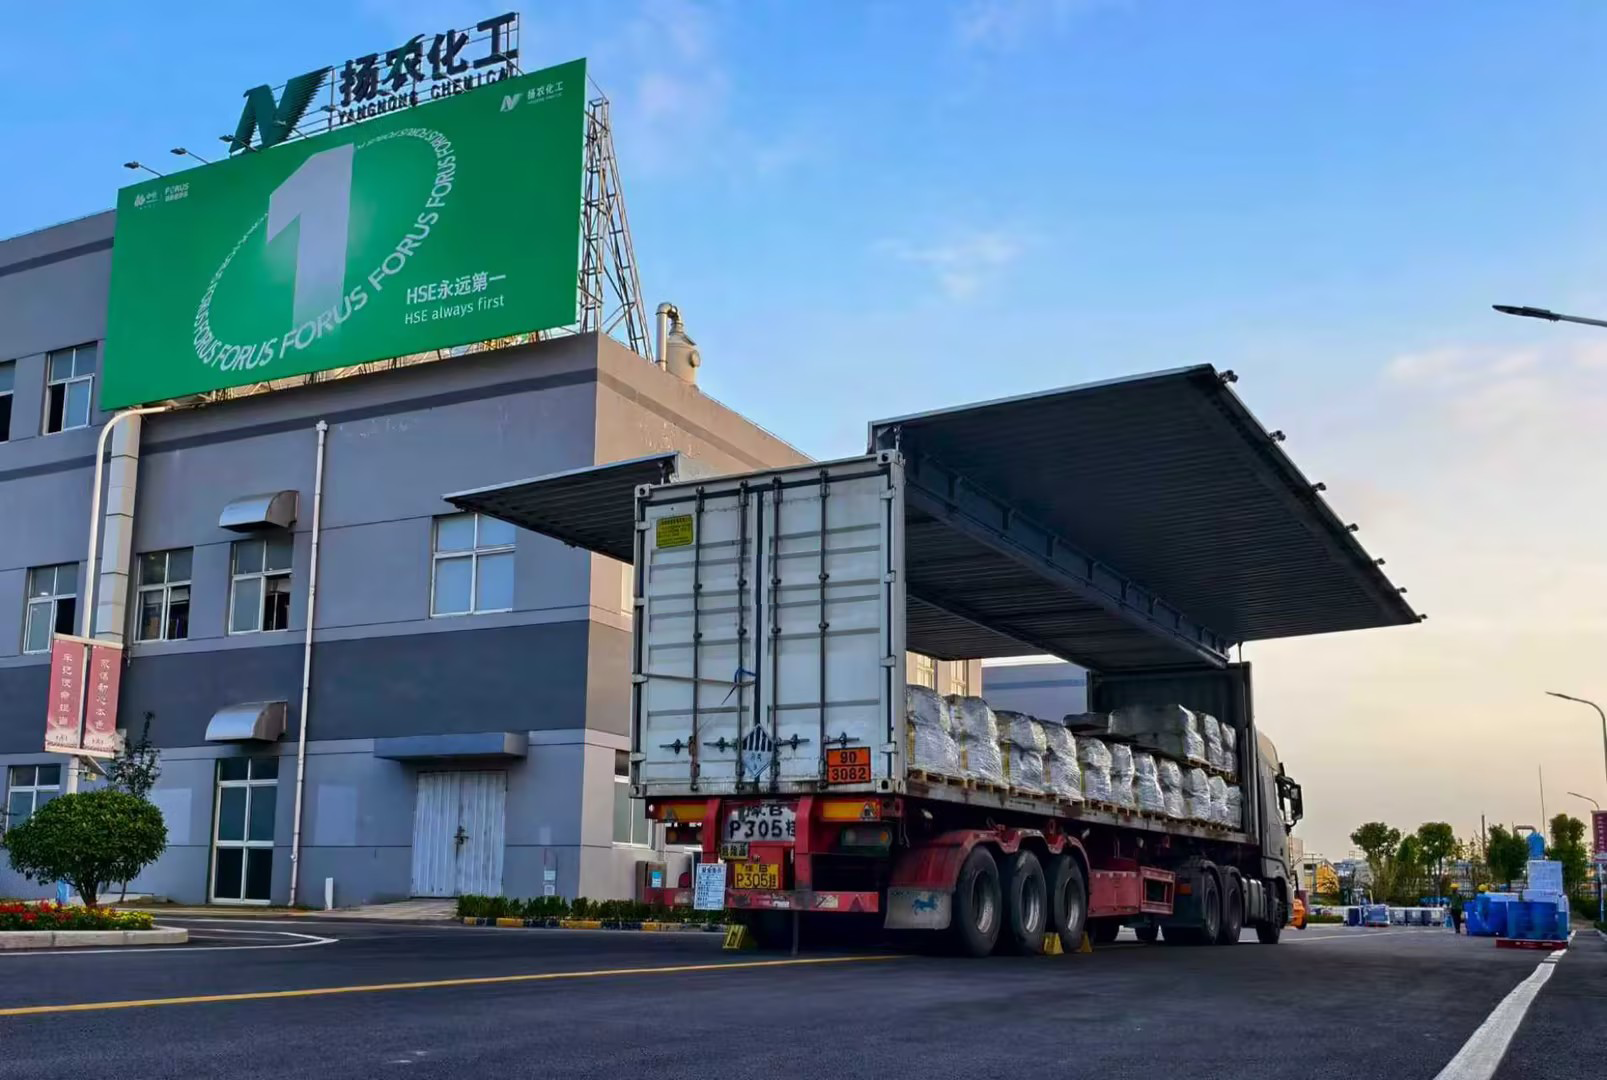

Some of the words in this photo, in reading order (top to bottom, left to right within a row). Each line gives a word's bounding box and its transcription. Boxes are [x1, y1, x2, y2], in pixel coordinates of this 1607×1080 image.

[339, 12, 519, 107] 扬农化工
[211, 337, 278, 371] FORUS
[279, 285, 368, 359] FORUS
[367, 212, 440, 292] FORUS
[425, 155, 457, 208] FORUS
[406, 271, 507, 305] HSE永远第一
[404, 309, 429, 325] HSE
[431, 303, 474, 318] always
[478, 294, 505, 311] first
[840, 751, 857, 764] 90
[831, 767, 866, 781] 3082
